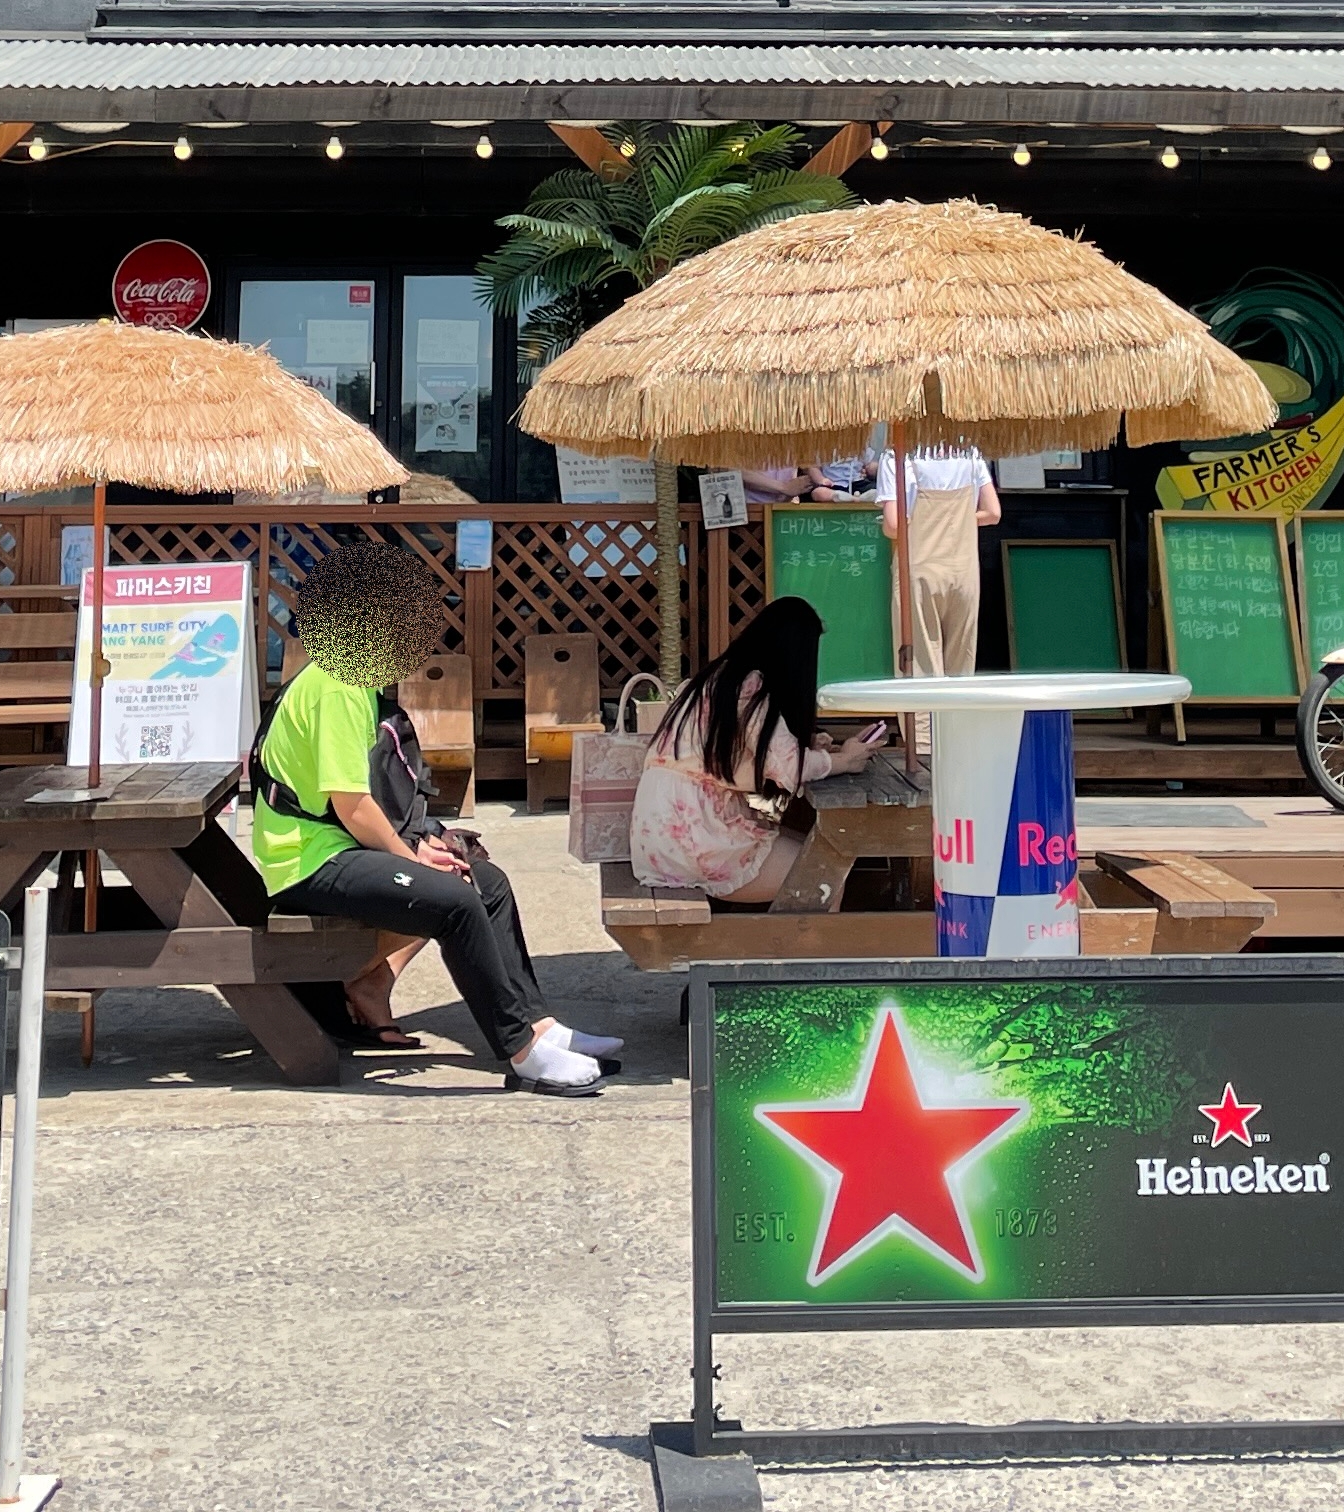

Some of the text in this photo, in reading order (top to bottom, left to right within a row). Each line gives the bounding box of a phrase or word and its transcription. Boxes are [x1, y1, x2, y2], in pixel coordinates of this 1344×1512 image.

[1227, 451, 1322, 512] KITCHEN
[1281, 481, 1319, 516] SINCE
[780, 518, 827, 536] 대기실
[1308, 531, 1341, 553] 영업
[1312, 559, 1338, 577] 오전
[115, 575, 212, 597] 파머스키친
[102, 620, 207, 633] MART SURF CITY
[102, 635, 166, 646] ANG YANG
[934, 818, 975, 865] ull
[1136, 1156, 1331, 1195] Heineken
[733, 1208, 1058, 1244] EST. 1873
